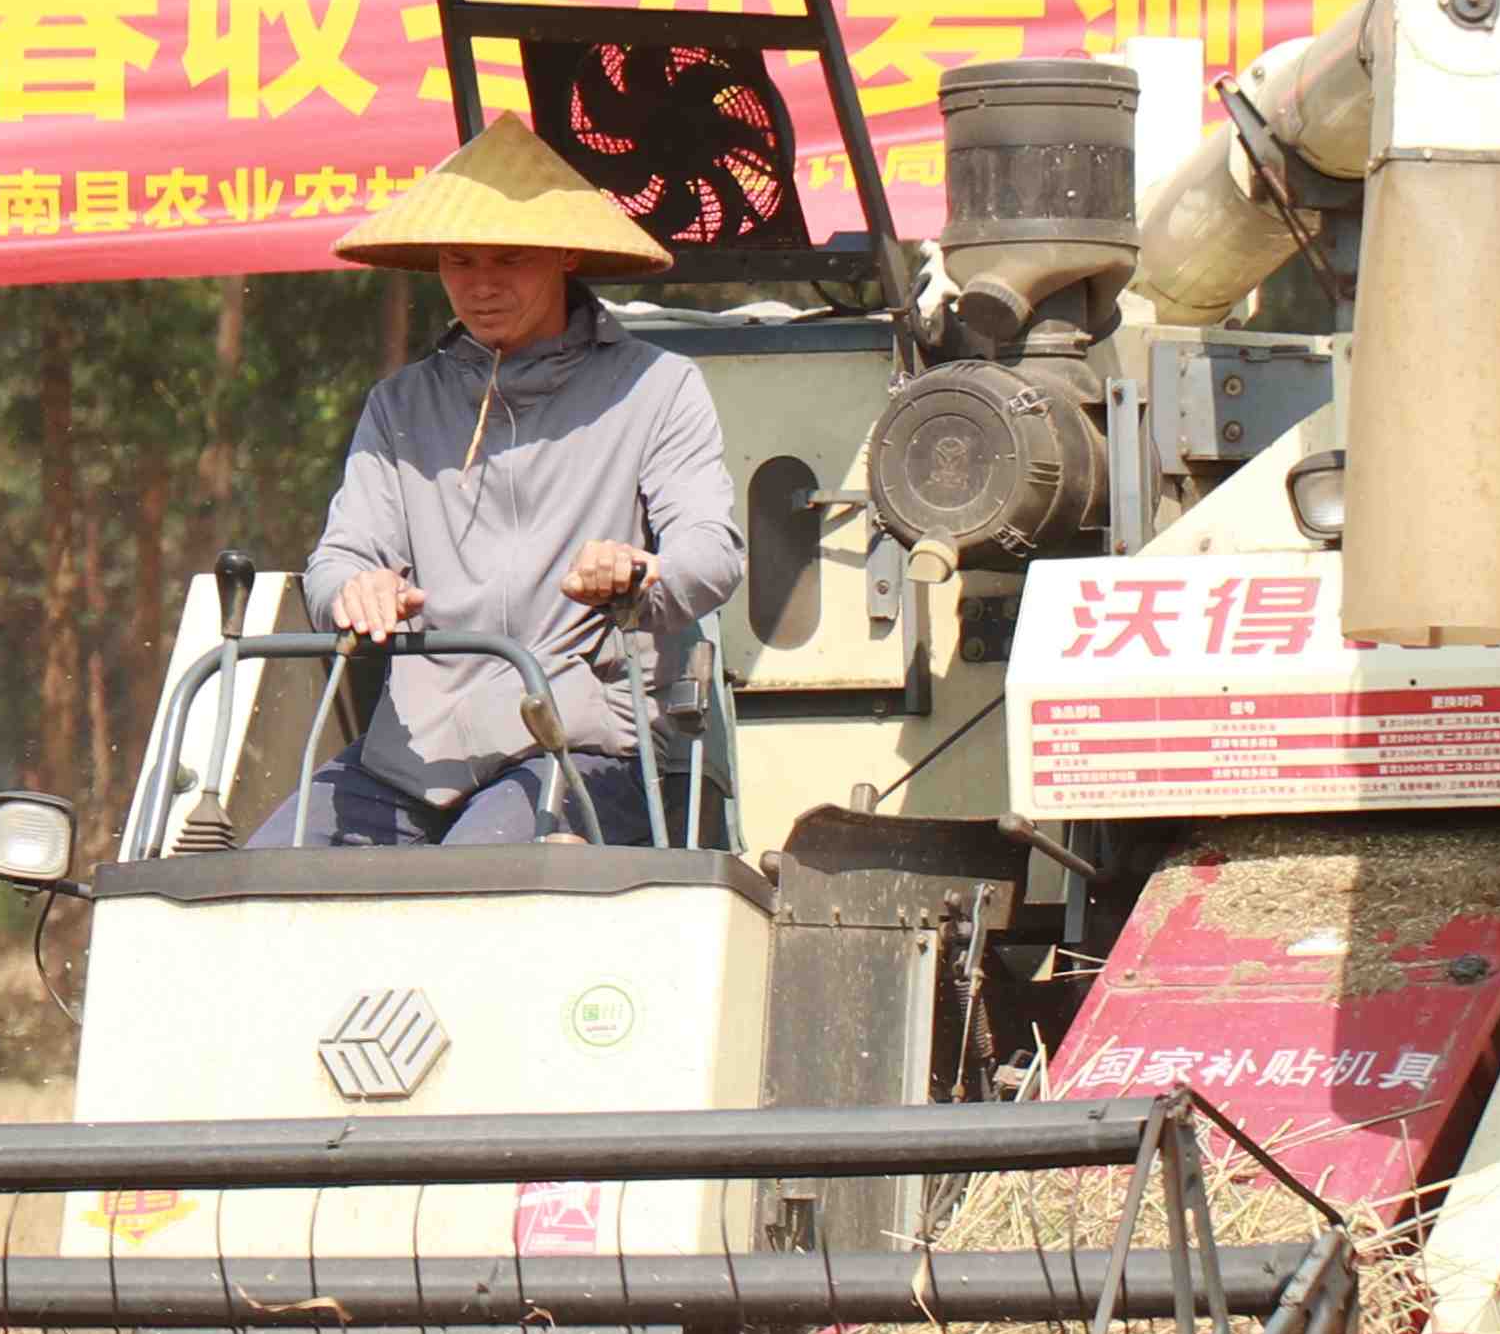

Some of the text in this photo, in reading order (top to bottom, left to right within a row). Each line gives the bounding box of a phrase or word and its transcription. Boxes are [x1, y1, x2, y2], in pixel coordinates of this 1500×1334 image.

[1074, 1046, 1441, 1092] 国家补贴机具
